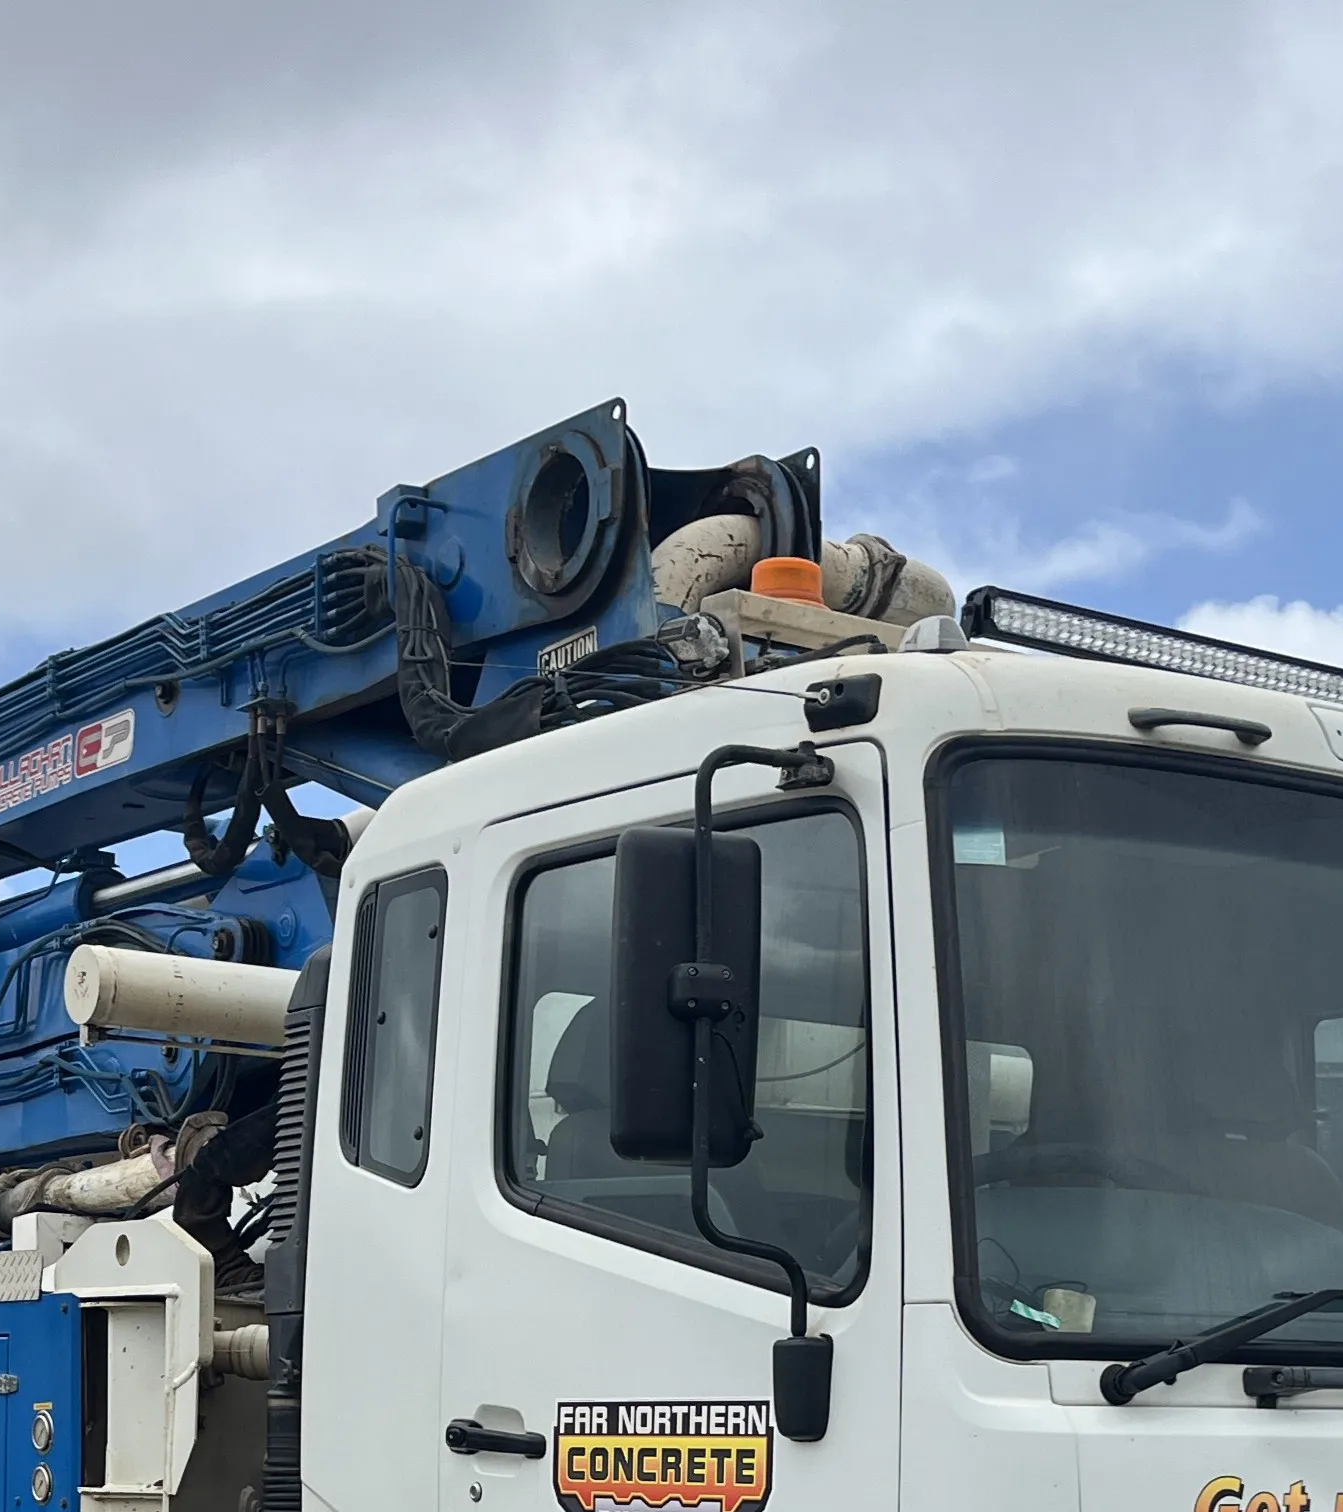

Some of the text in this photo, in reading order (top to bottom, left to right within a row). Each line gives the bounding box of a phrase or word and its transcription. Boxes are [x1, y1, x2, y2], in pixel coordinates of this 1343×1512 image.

[541, 632, 594, 678] CAUTION
[559, 1404, 767, 1435] FAR NORTHERN
[567, 1446, 756, 1484] CONCRETE
